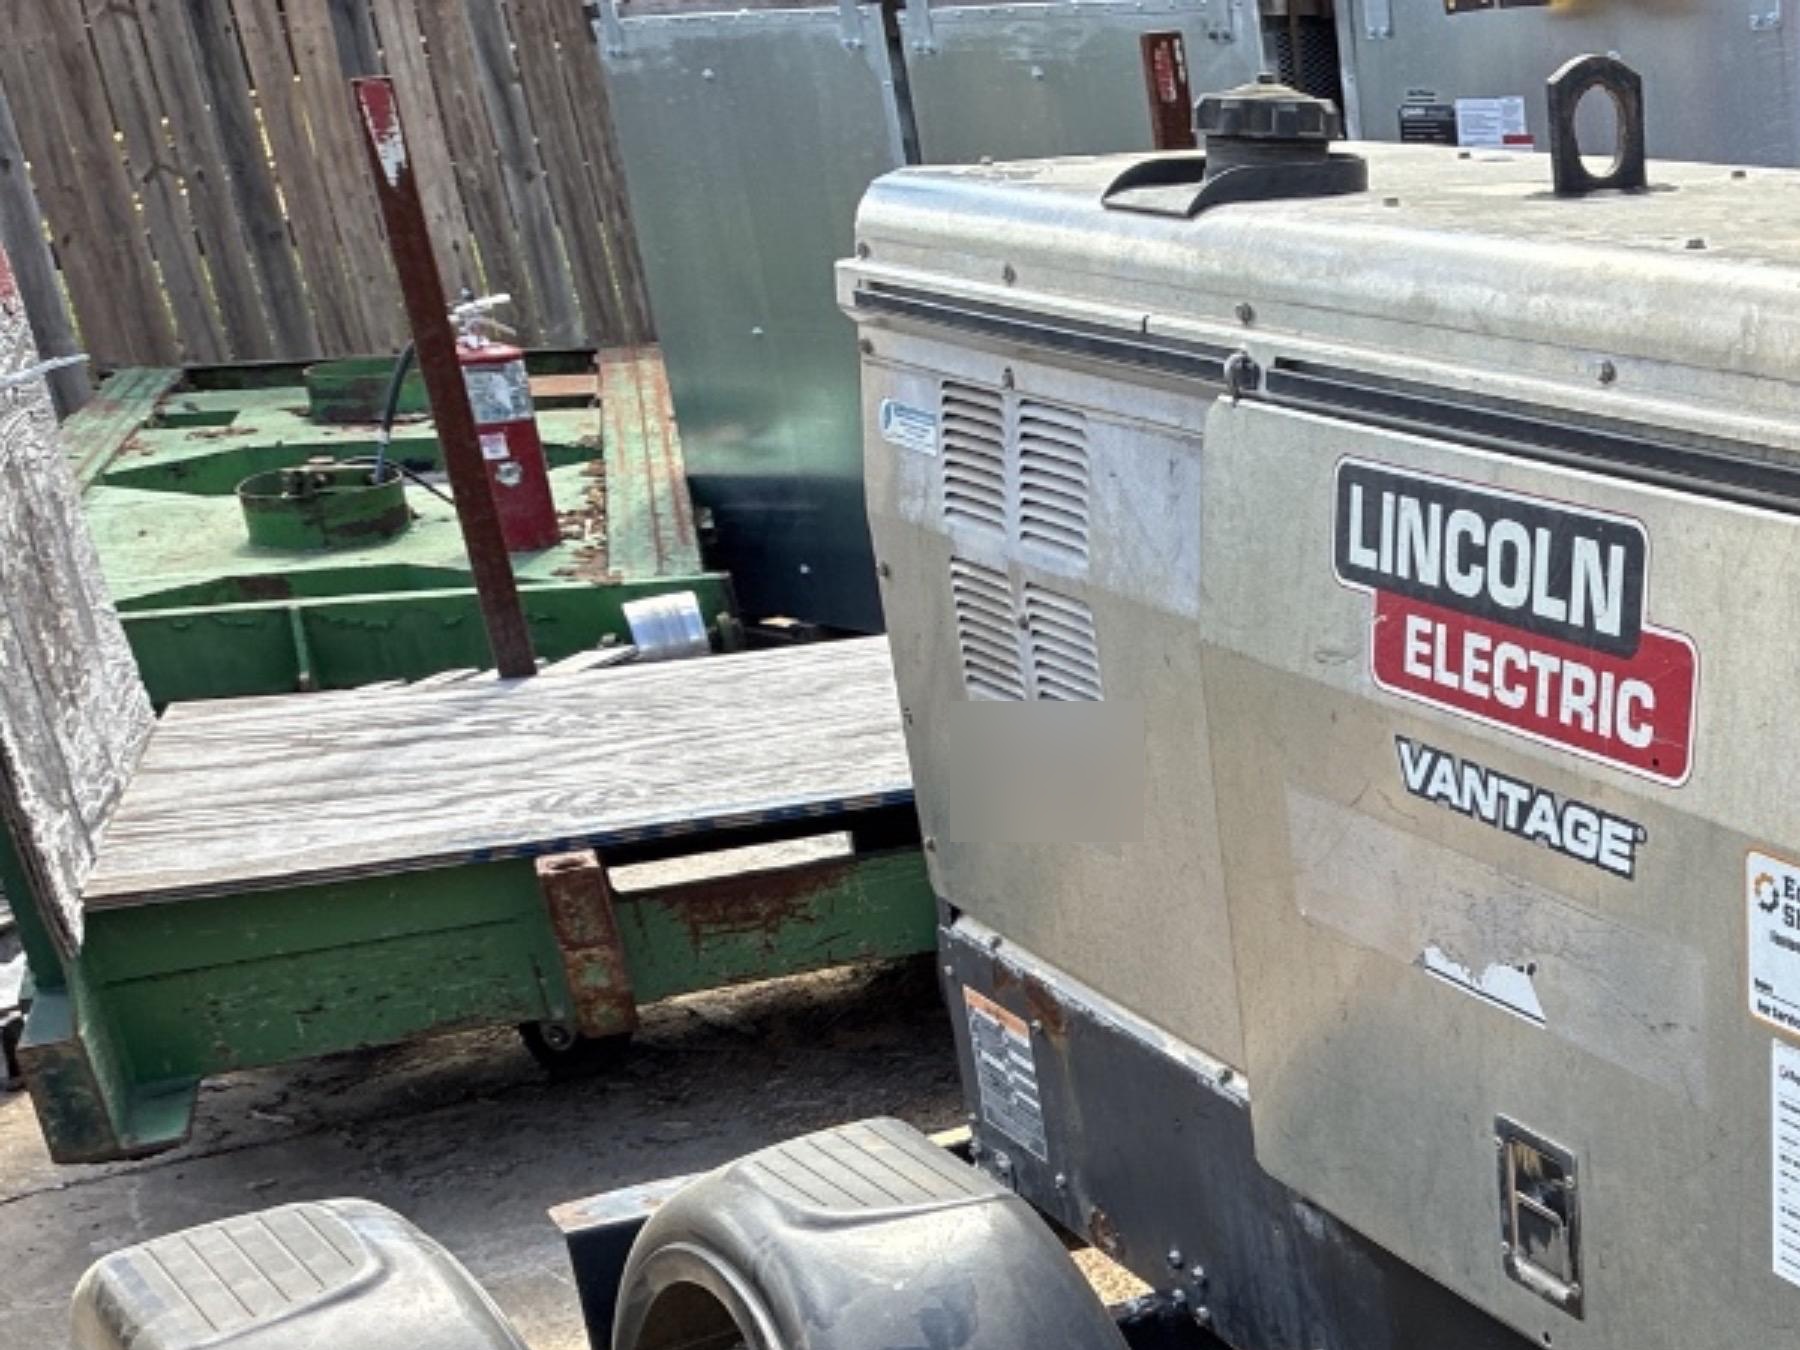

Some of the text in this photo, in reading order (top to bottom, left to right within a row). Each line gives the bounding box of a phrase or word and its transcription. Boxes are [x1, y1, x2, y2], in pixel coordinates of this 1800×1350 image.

[1349, 484, 1626, 638] LINCOLN
[1404, 614, 1656, 749] ELECTRIC
[1396, 736, 1640, 879] VANTAGE
